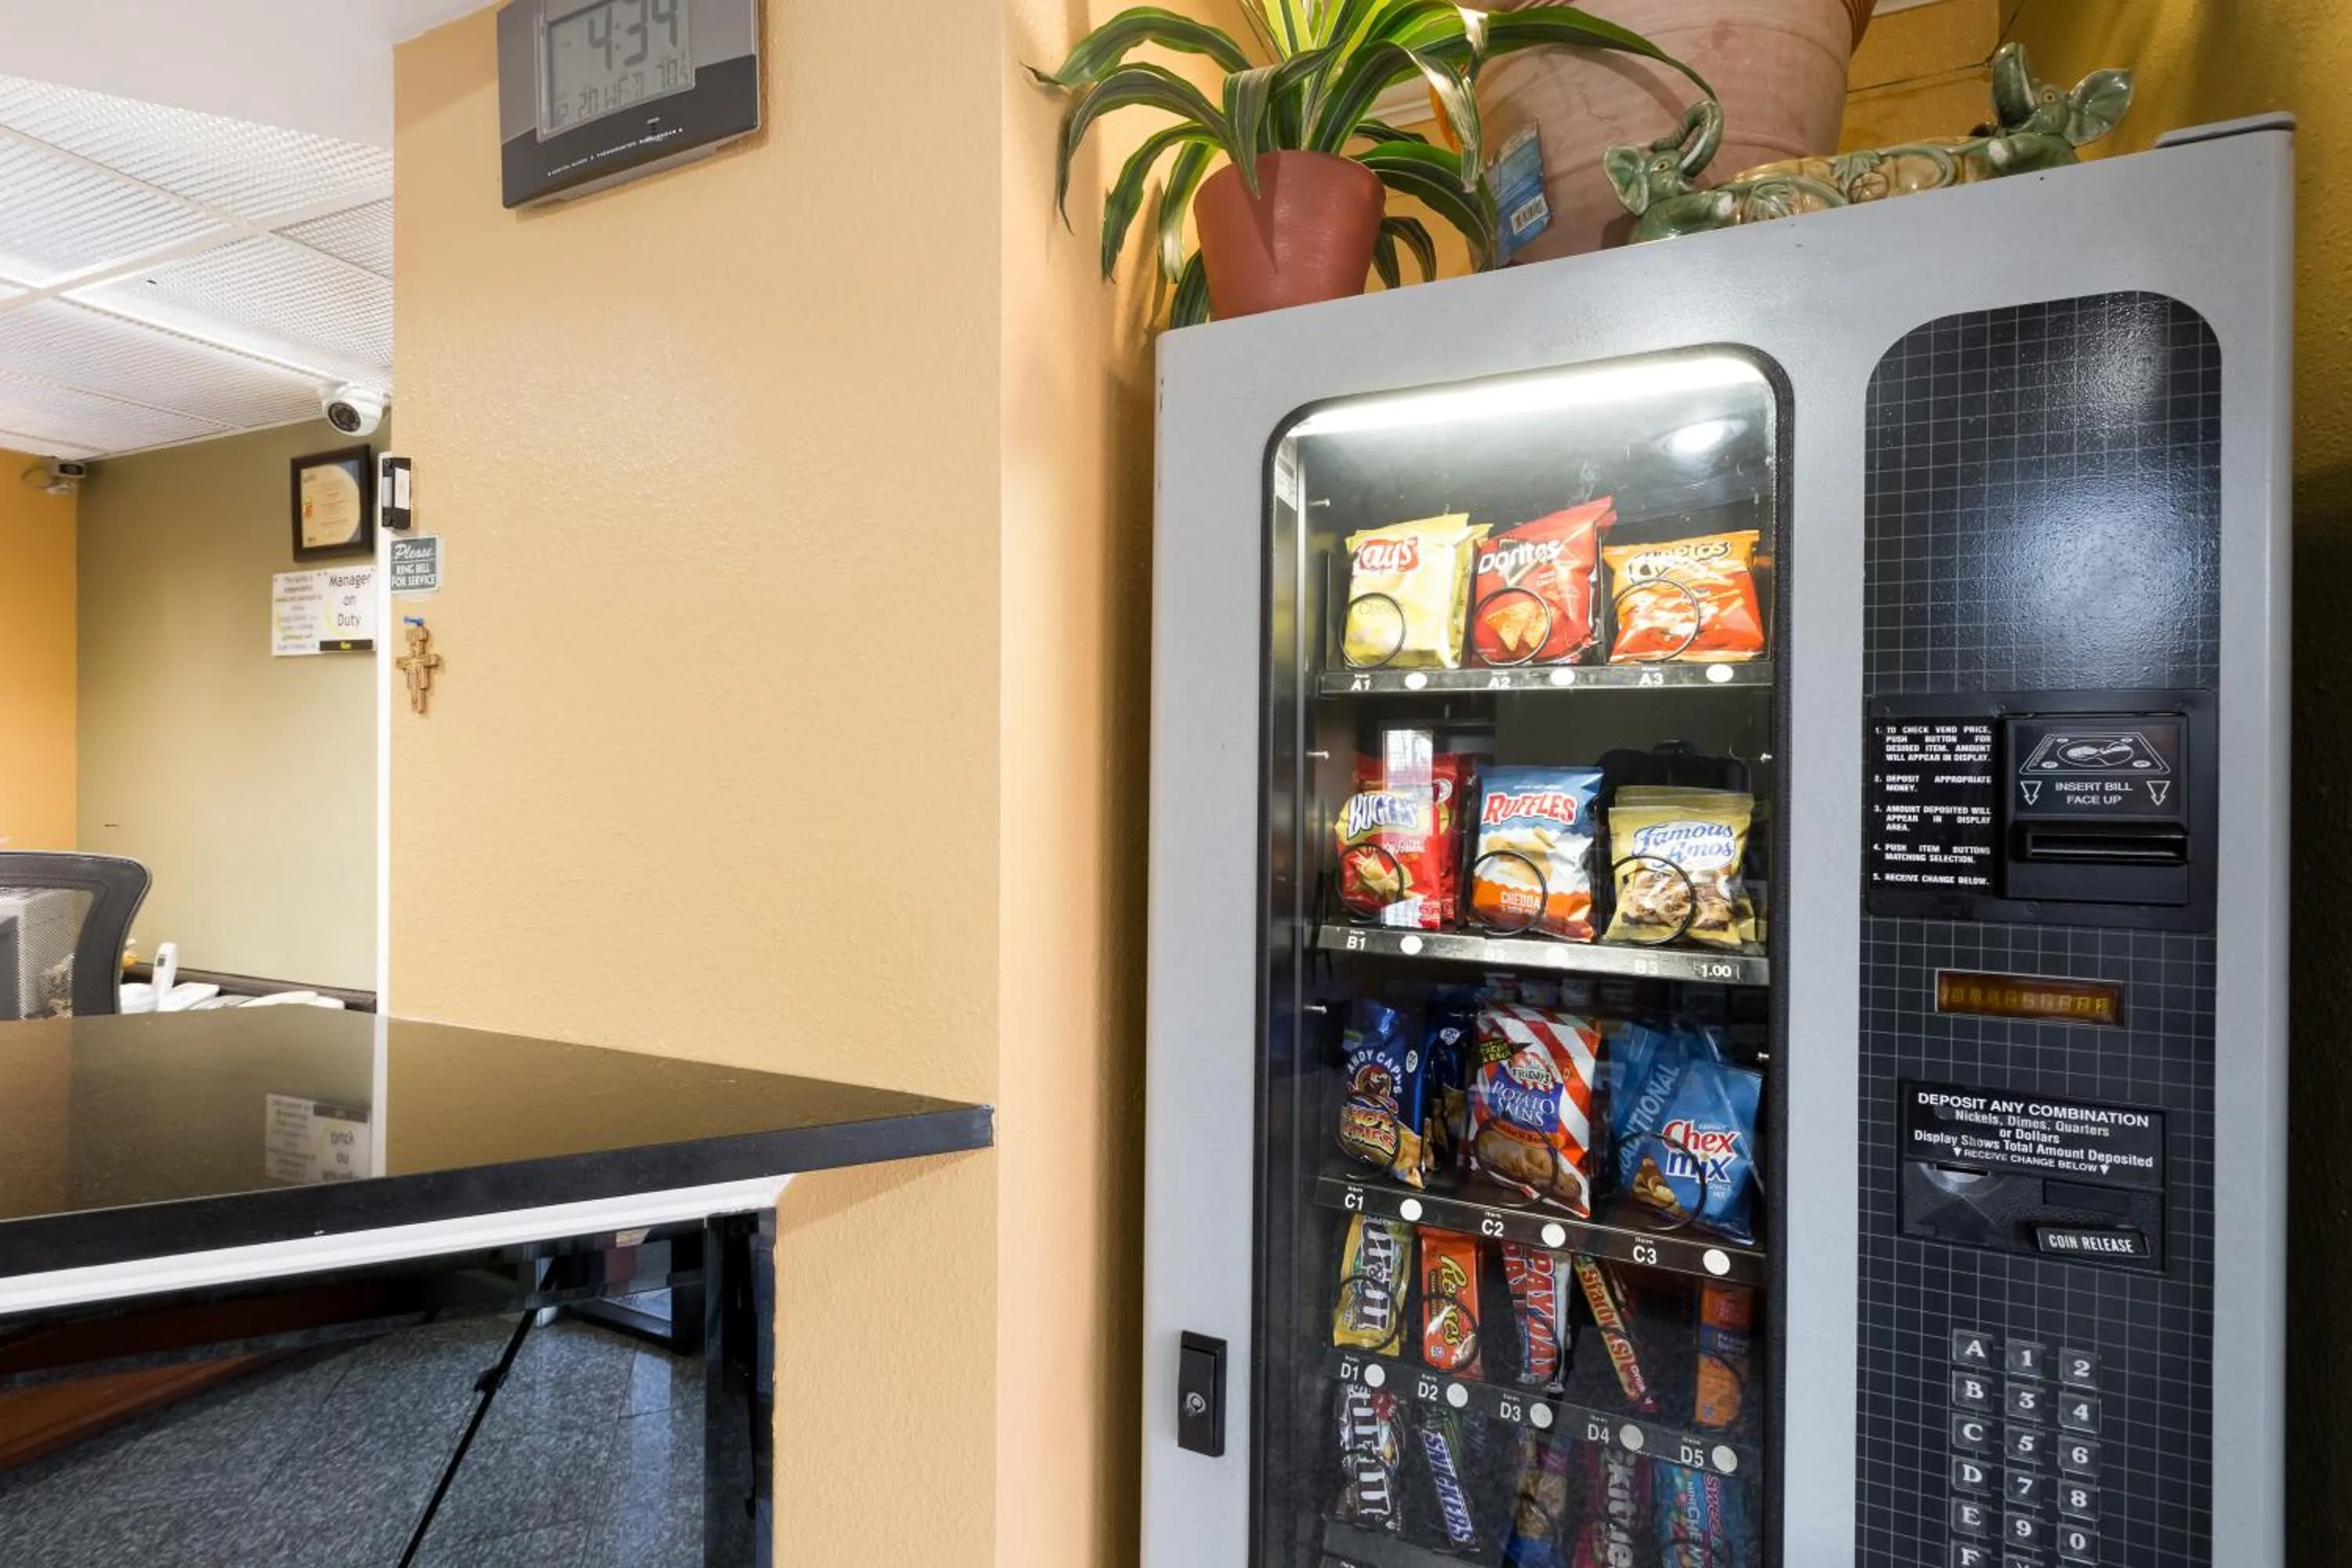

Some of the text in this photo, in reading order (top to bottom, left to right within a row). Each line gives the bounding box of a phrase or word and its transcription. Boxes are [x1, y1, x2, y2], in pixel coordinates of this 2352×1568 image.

[394, 544, 434, 559] Please
[1479, 540, 1560, 575] Doritos
[397, 562, 430, 574] RING BELL
[329, 574, 372, 589] Manager
[392, 575, 436, 586] FOR SERVICE
[343, 595, 356, 606] on
[338, 613, 361, 627] Duty
[1352, 679, 1372, 690] A1
[1488, 677, 1512, 689] A2
[1639, 673, 1664, 685] A3
[2055, 782, 2132, 791] INSERT BILL
[2066, 795, 2122, 804] FACE UP
[1923, 806, 1968, 815] DEPOSITED
[1632, 823, 1734, 861] Famous
[1885, 853, 1976, 863] MATCHING SELECTION.
[1885, 873, 1918, 882] RECEIVE
[1958, 877, 1989, 885] BELOW.
[1501, 891, 1543, 910] CHEDDA
[1346, 935, 1366, 950] B1
[1700, 964, 1732, 978] 1.00
[1347, 1049, 1374, 1074] ANDY
[1492, 1080, 1555, 1115] POTATO
[1498, 1098, 1544, 1127] SKINS
[1918, 1093, 2149, 1127] DEPOSIT ANY COMBINATION
[1955, 1110, 2111, 1137] Nickels, Dimes, Quarters
[1662, 1120, 1737, 1154] Chex
[1999, 1128, 2060, 1144] or Dollars
[1914, 1130, 2154, 1167] Display Shows Total Amount Deposited
[1964, 1149, 2098, 1172] RECEIVE CHANGE BELOW
[1345, 1193, 1364, 1210] C1
[1481, 1219, 1504, 1238] C2
[2049, 1234, 2135, 1254] COIN RELEASE
[1633, 1246, 1657, 1265] C3
[1965, 1340, 2091, 1377] A 1 2
[1340, 1363, 1359, 1381] D1
[1417, 1381, 1439, 1401] D2
[1965, 1380, 2089, 1421] B 3 4
[1500, 1402, 1521, 1421] D3
[1588, 1423, 1610, 1443] D4
[1963, 1423, 2089, 1464] C 5 6
[1680, 1445, 1704, 1468] D5
[1963, 1464, 2087, 1508] D 7 8
[1962, 1505, 2086, 1550] E 9 0
[1962, 1548, 1982, 1566] F
